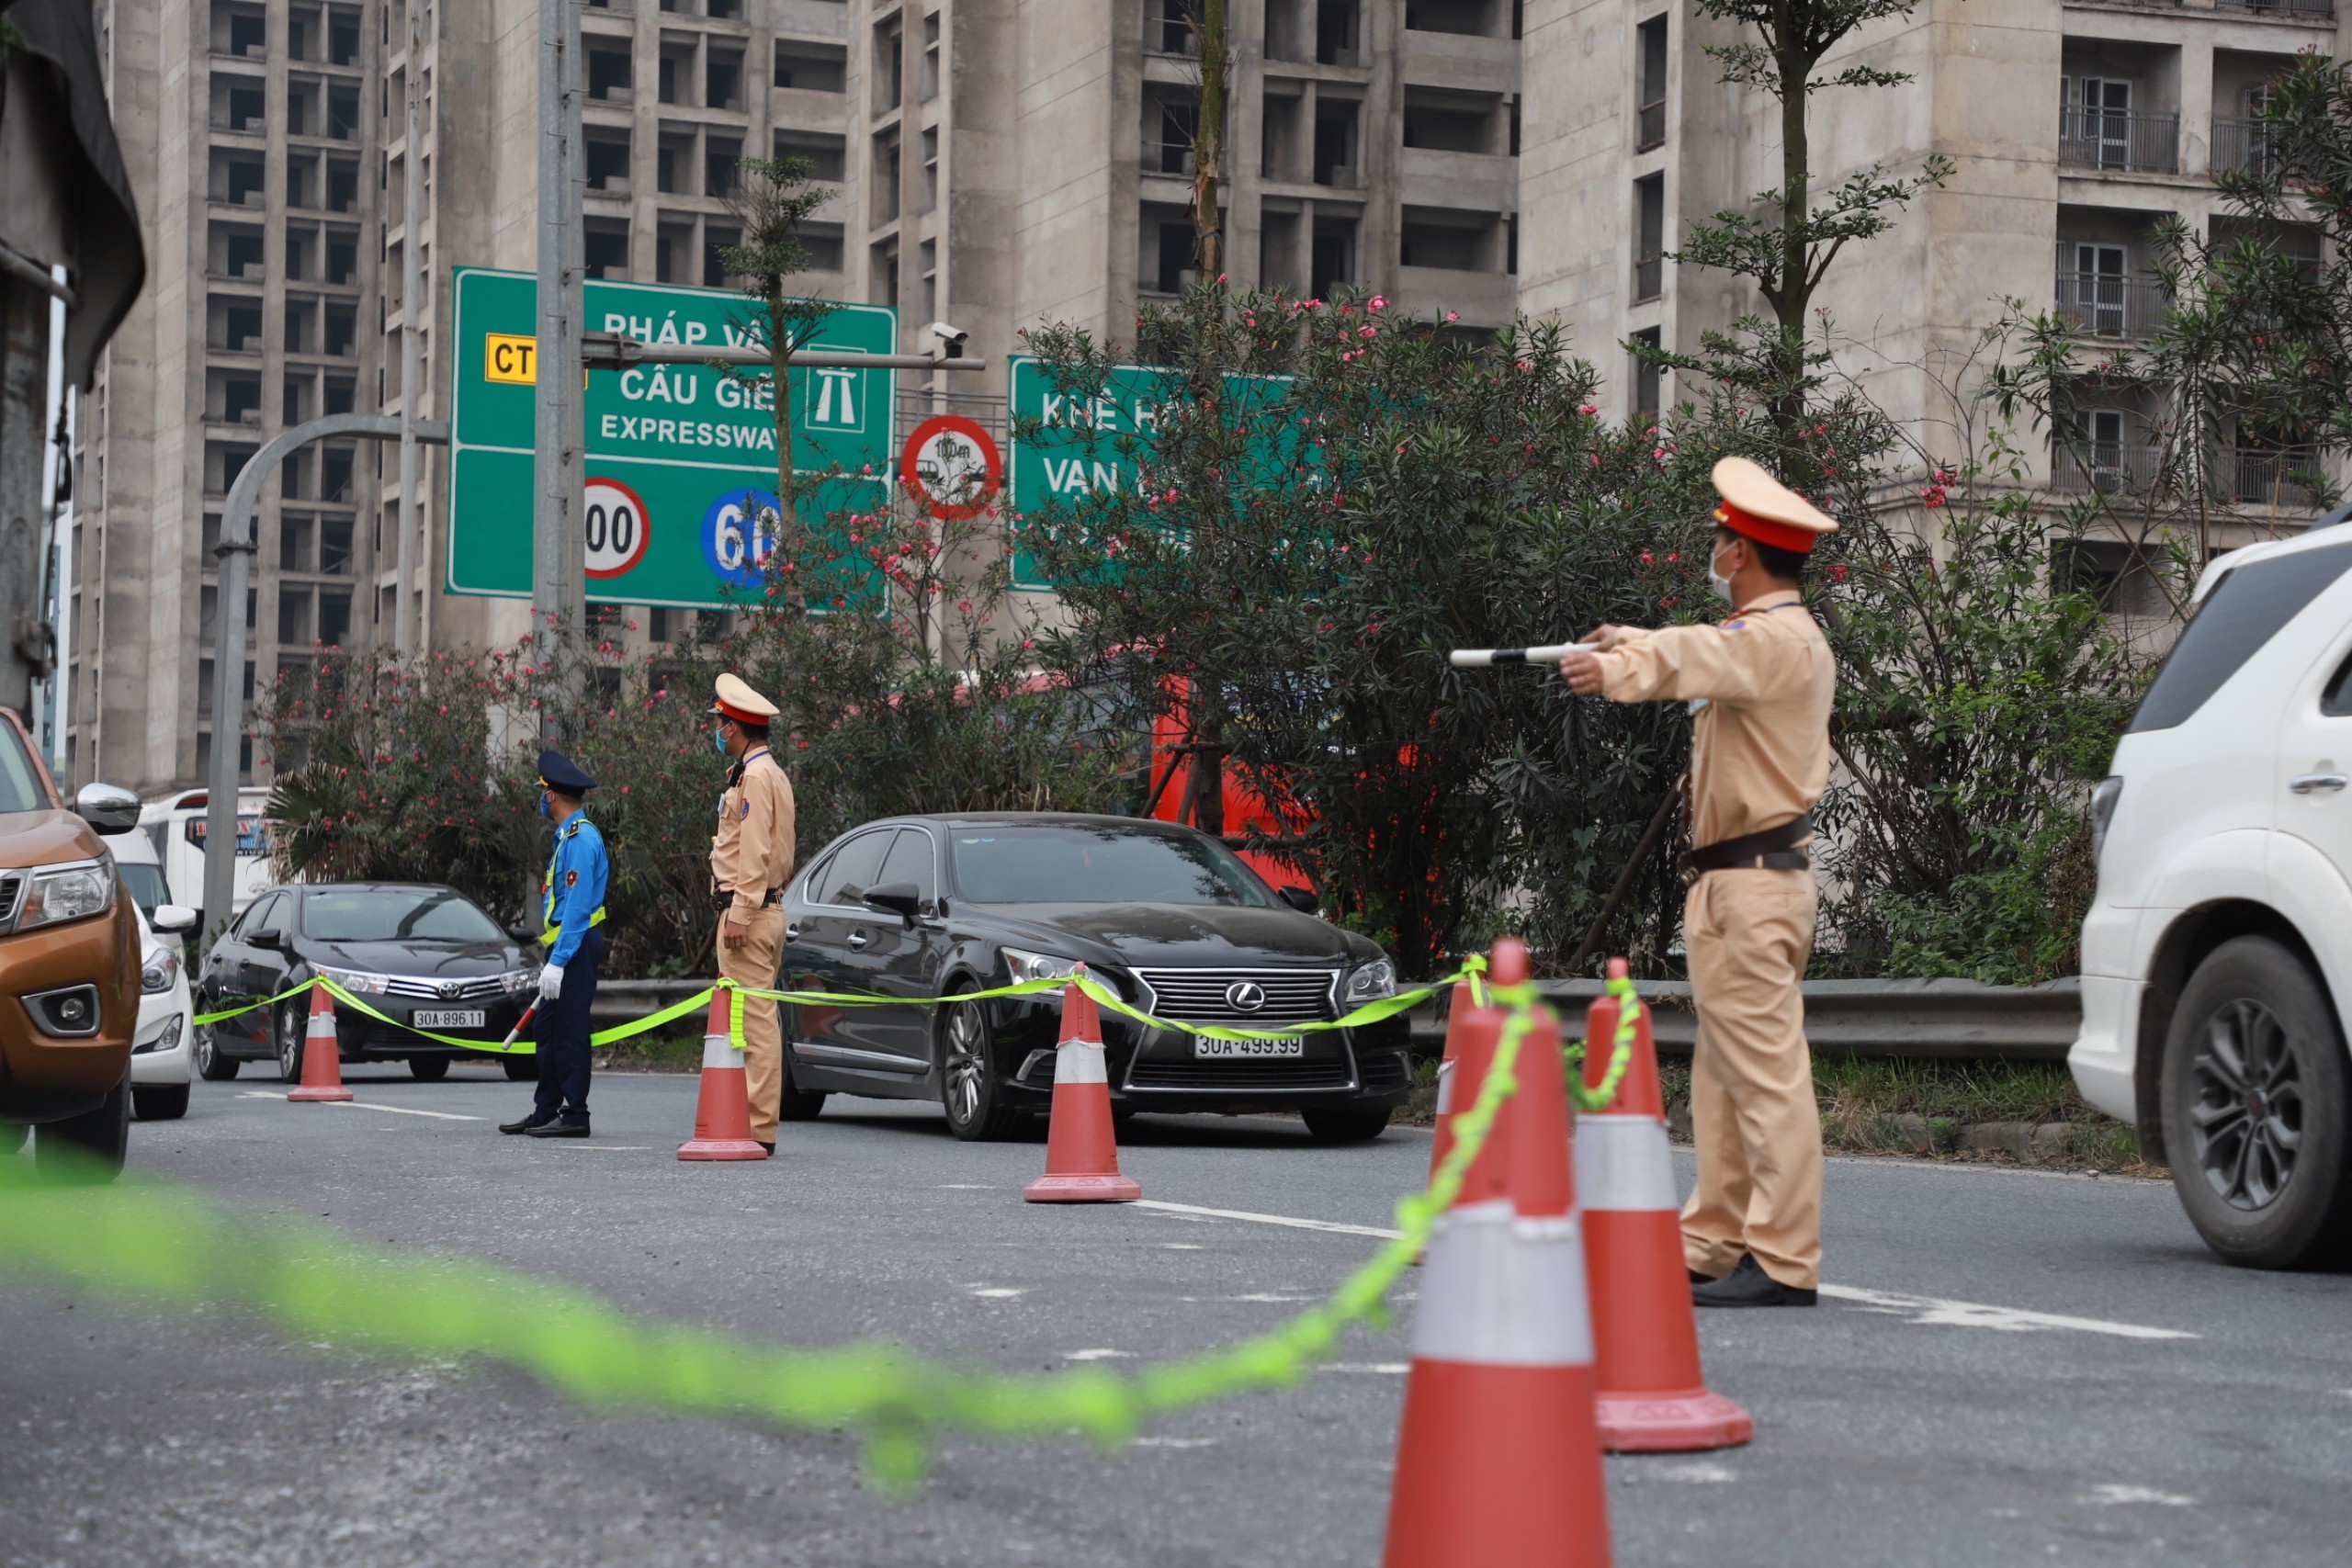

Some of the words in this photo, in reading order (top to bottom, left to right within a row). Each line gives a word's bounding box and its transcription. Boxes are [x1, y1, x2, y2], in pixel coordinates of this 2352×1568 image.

[605, 310, 707, 345] PHÁP
[723, 319, 795, 351] VÂ
[1043, 387, 1117, 431] KHÊ
[585, 504, 633, 554] 00
[715, 503, 781, 571] 60
